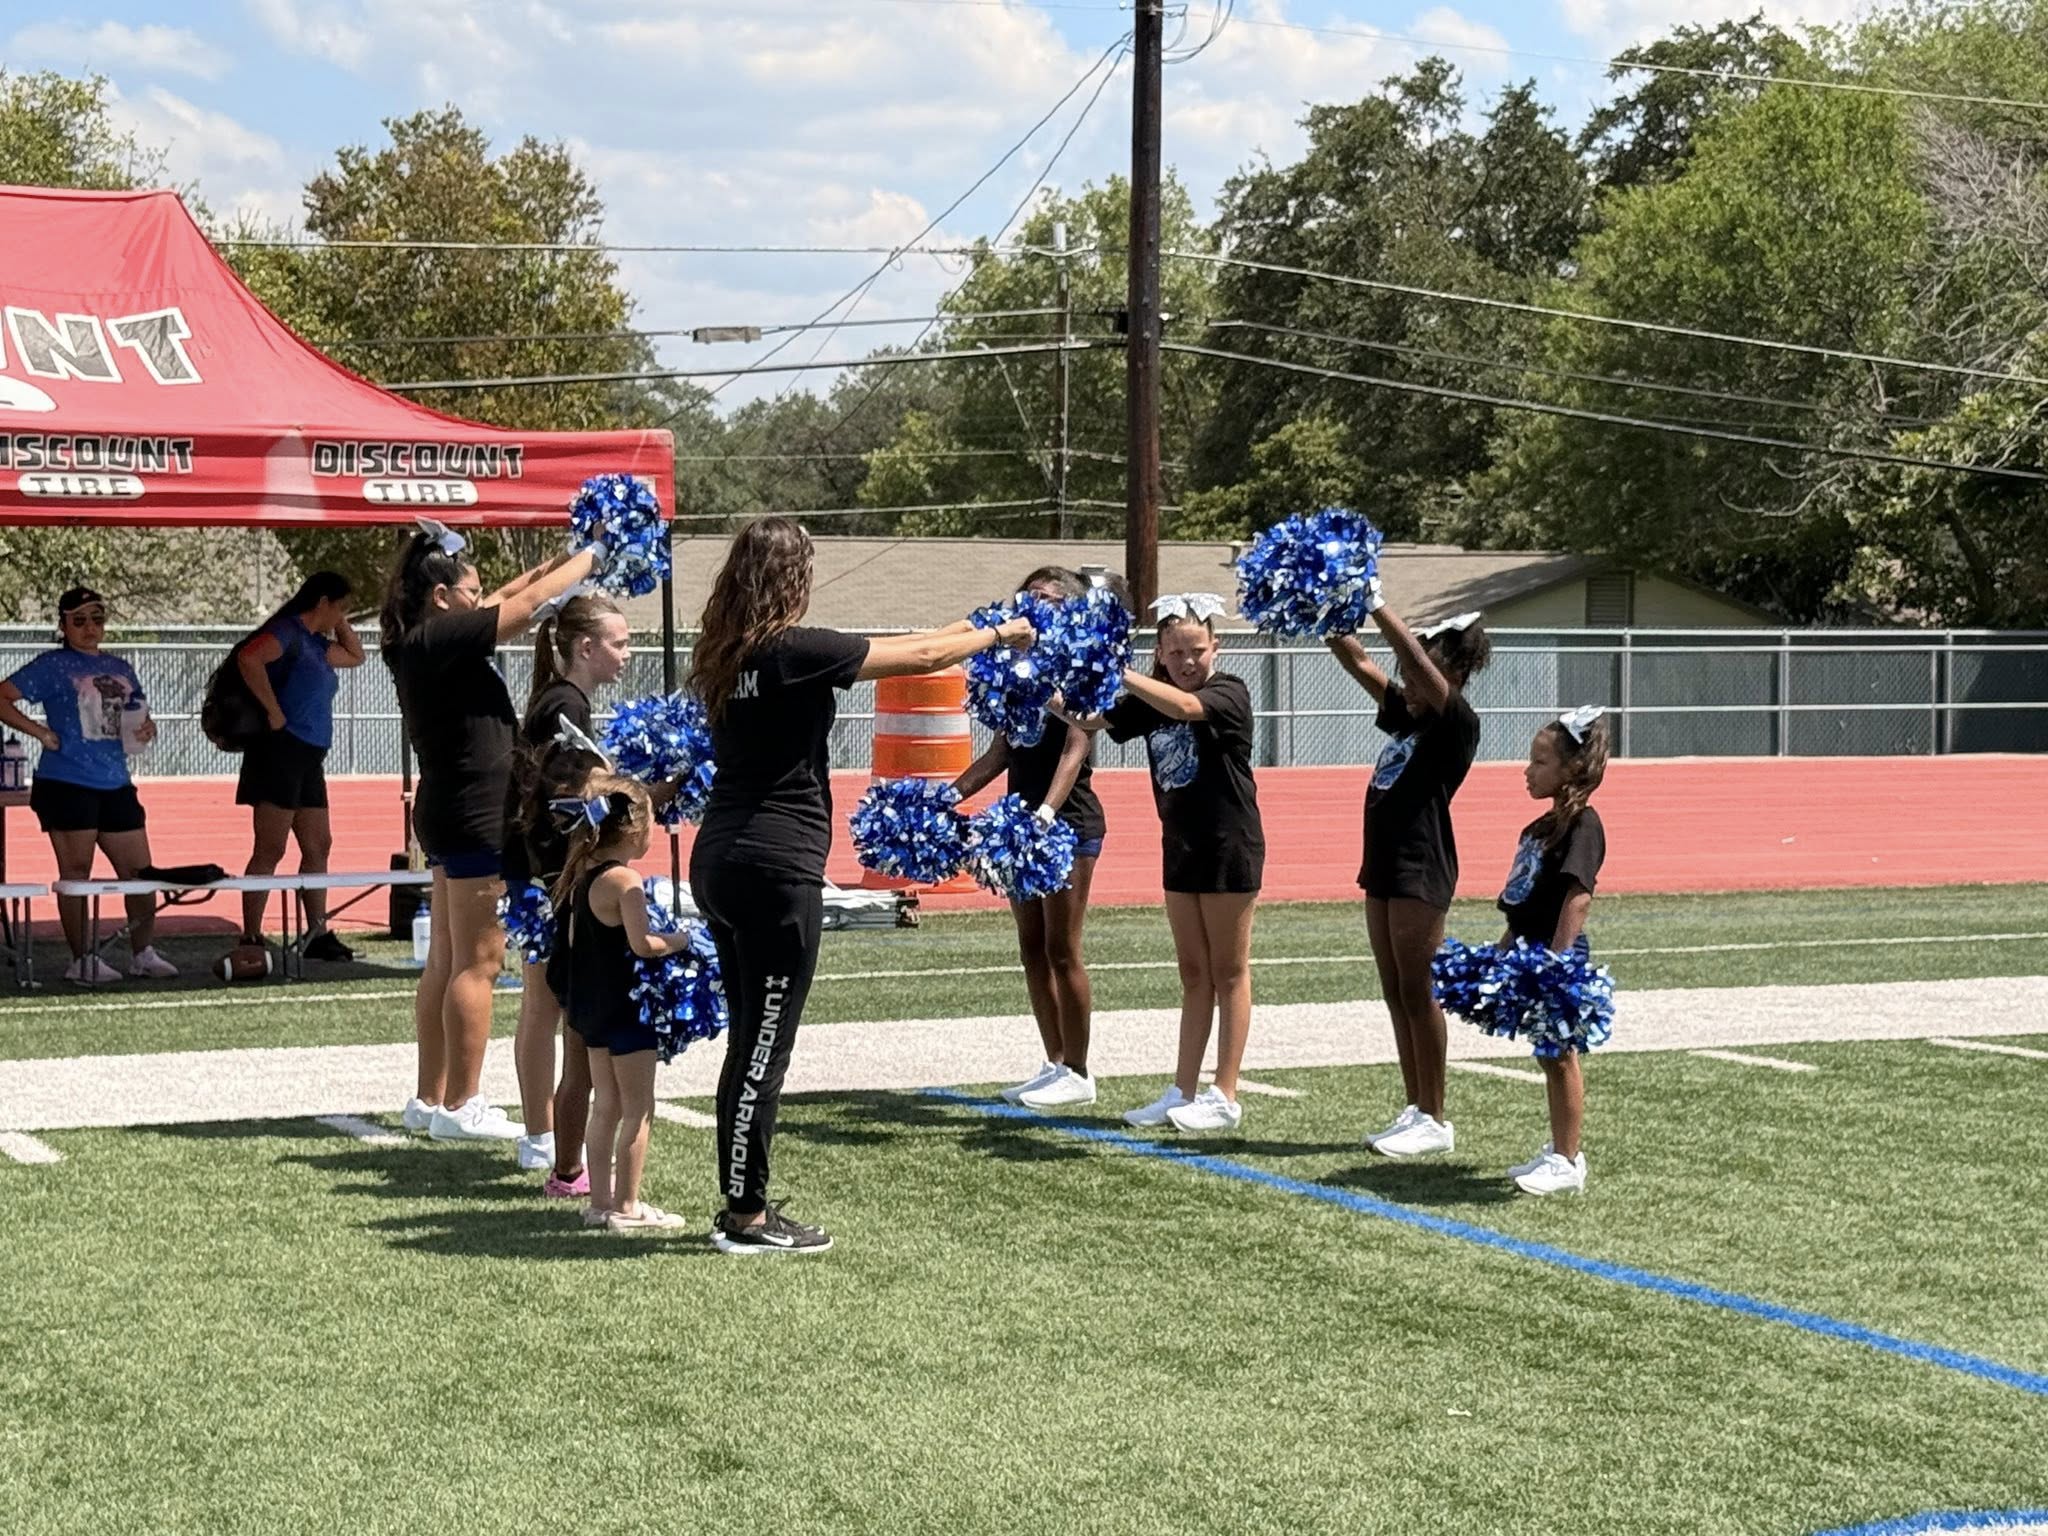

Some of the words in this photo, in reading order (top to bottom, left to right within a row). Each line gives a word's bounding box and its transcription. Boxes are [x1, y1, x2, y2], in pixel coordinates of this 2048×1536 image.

[0, 305, 205, 385] NT
[311, 440, 524, 479] DISCOUNT
[29, 477, 132, 496] TIRE
[372, 483, 467, 503] TIRE
[728, 670, 760, 699] AM
[746, 992, 784, 1082] UNDER
[728, 1081, 759, 1199] ARMOUR
